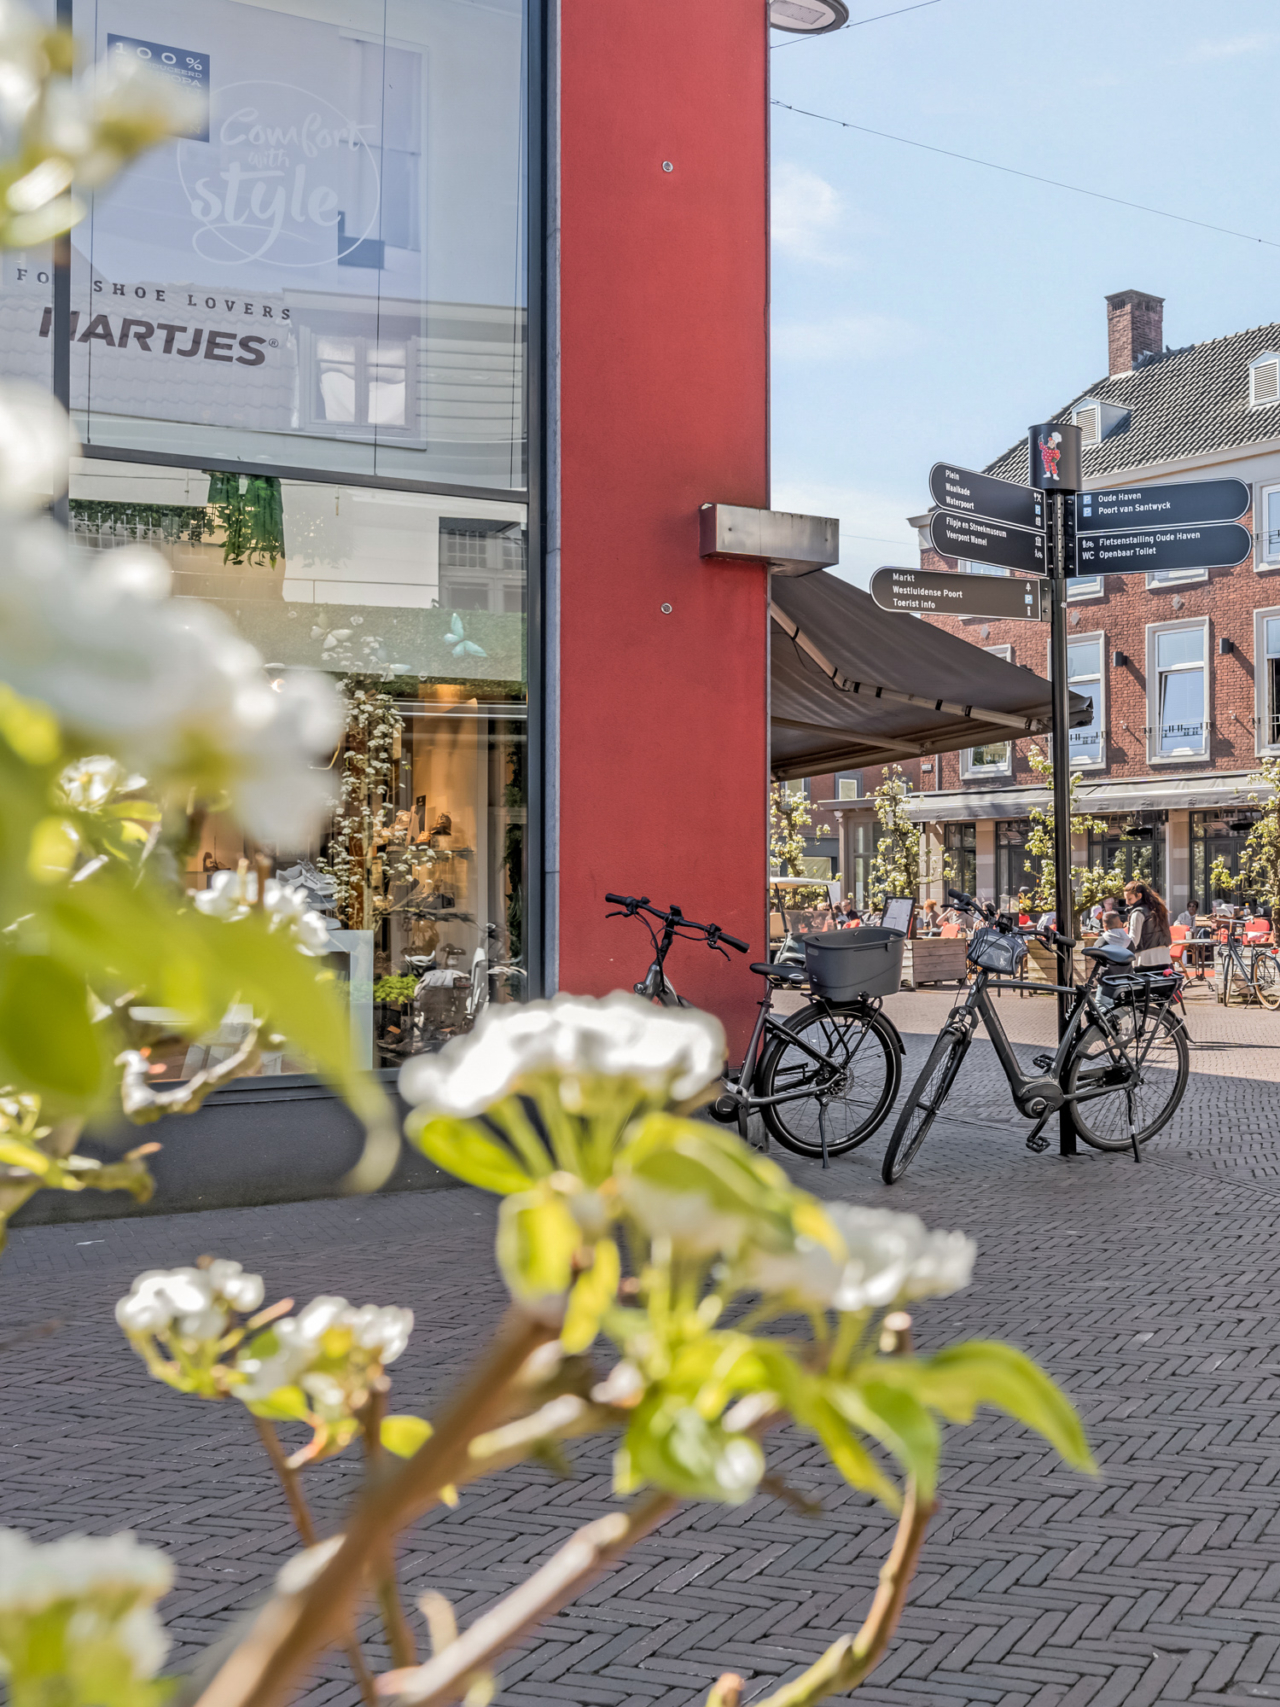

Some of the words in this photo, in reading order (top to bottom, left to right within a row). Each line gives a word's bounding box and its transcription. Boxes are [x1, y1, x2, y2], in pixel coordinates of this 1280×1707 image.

[115, 42, 203, 71] 100%
[220, 108, 376, 157] Comfort
[248, 149, 290, 168] with
[191, 161, 342, 242] style
[16, 268, 53, 285] FO
[93, 280, 166, 302] SHOE
[187, 294, 291, 320] LOVERS
[945, 469, 959, 481] Plein
[945, 482, 971, 496] Waalkade
[945, 495, 975, 510] Waterpoort
[1098, 494, 1117, 503] Oude
[1118, 492, 1142, 501] Haven
[1098, 505, 1118, 515] Poort
[1119, 505, 1134, 513] van
[1135, 501, 1171, 512] Santwyck
[946, 516, 961, 529] Flipje
[962, 521, 969, 529] en
[969, 521, 1007, 538] Streekmuseum
[946, 529, 970, 542] Veerpont
[970, 534, 988, 546] Wamel
[1099, 533, 1154, 547] Fietsenstalling
[1155, 532, 1175, 542] Oude
[1176, 531, 1201, 541] Haven
[1082, 551, 1095, 560] WC
[1099, 549, 1134, 560] Openbaar
[1135, 546, 1157, 556] Toilet
[892, 572, 915, 582] Markt
[892, 585, 942, 597] Westluidense
[943, 589, 963, 599] Poort
[893, 598, 920, 608] Toerist
